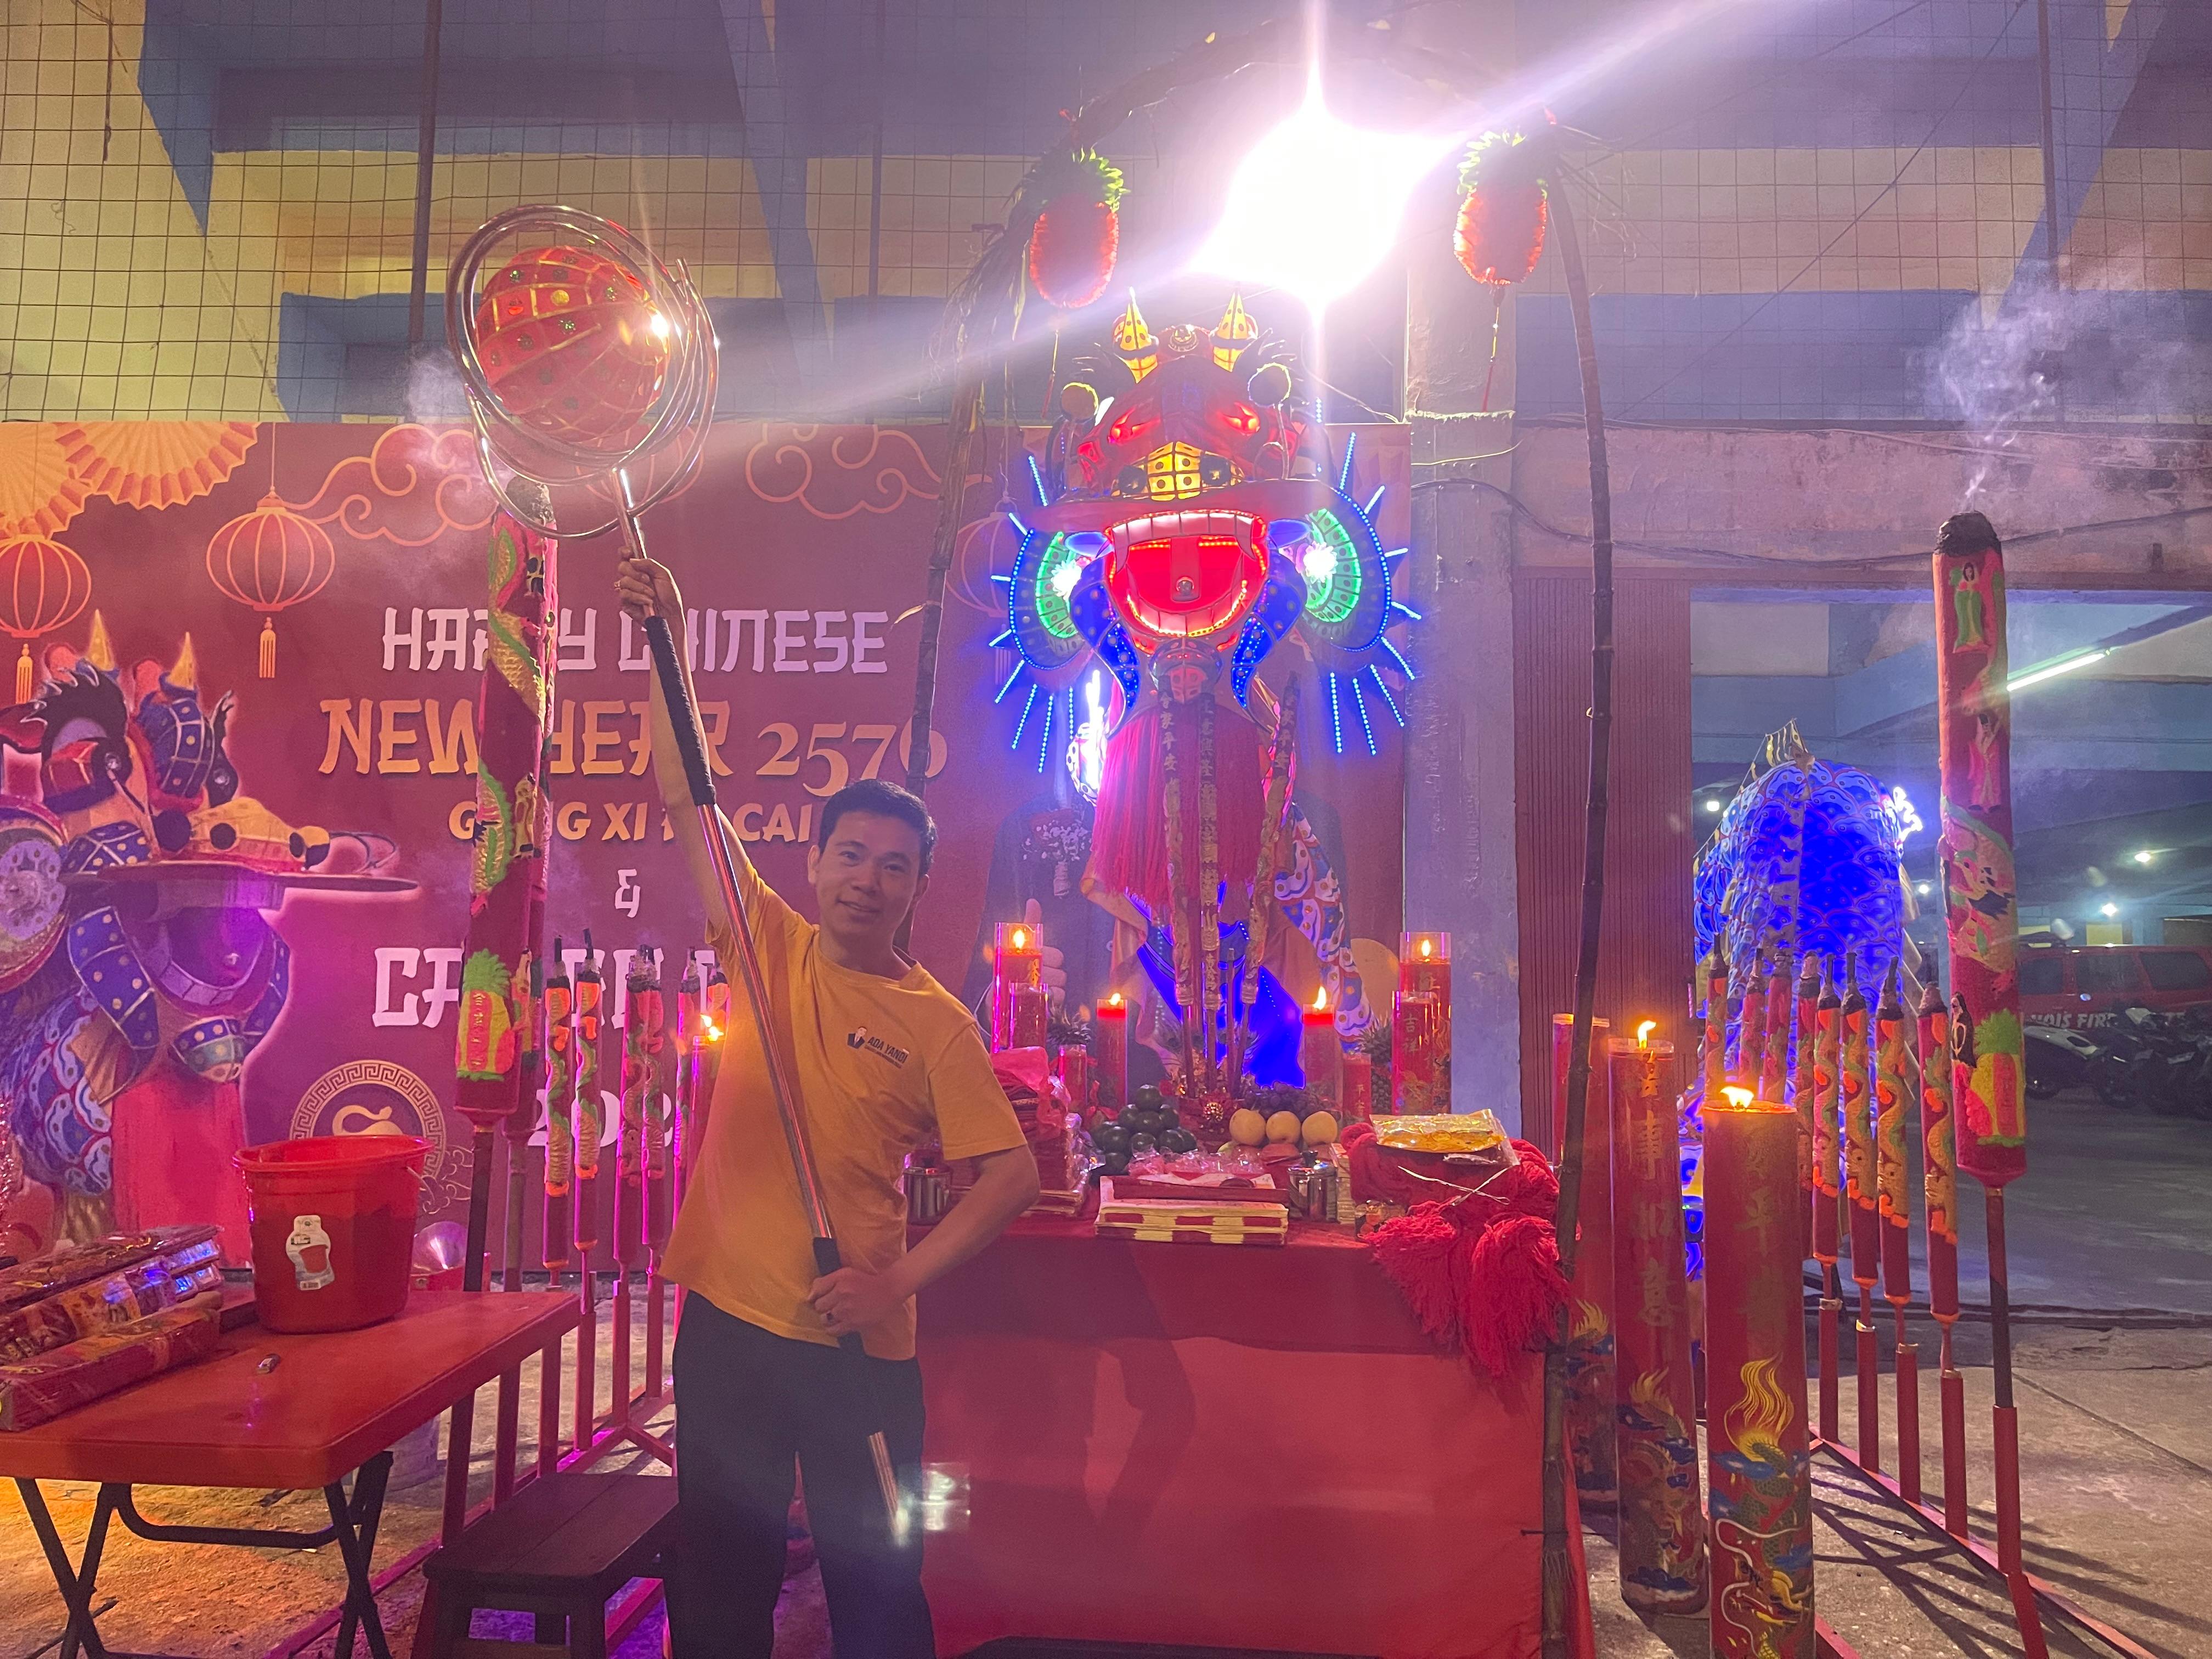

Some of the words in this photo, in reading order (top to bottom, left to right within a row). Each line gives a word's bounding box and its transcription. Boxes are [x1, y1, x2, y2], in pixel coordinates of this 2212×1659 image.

[382, 607, 597, 671] HAY
[318, 698, 479, 775] NEW
[601, 802, 648, 841] XI
[732, 802, 812, 843] CAI
[614, 868, 641, 918] &
[867, 1036, 885, 1051] ADA
[884, 1044, 909, 1064] YANDI
